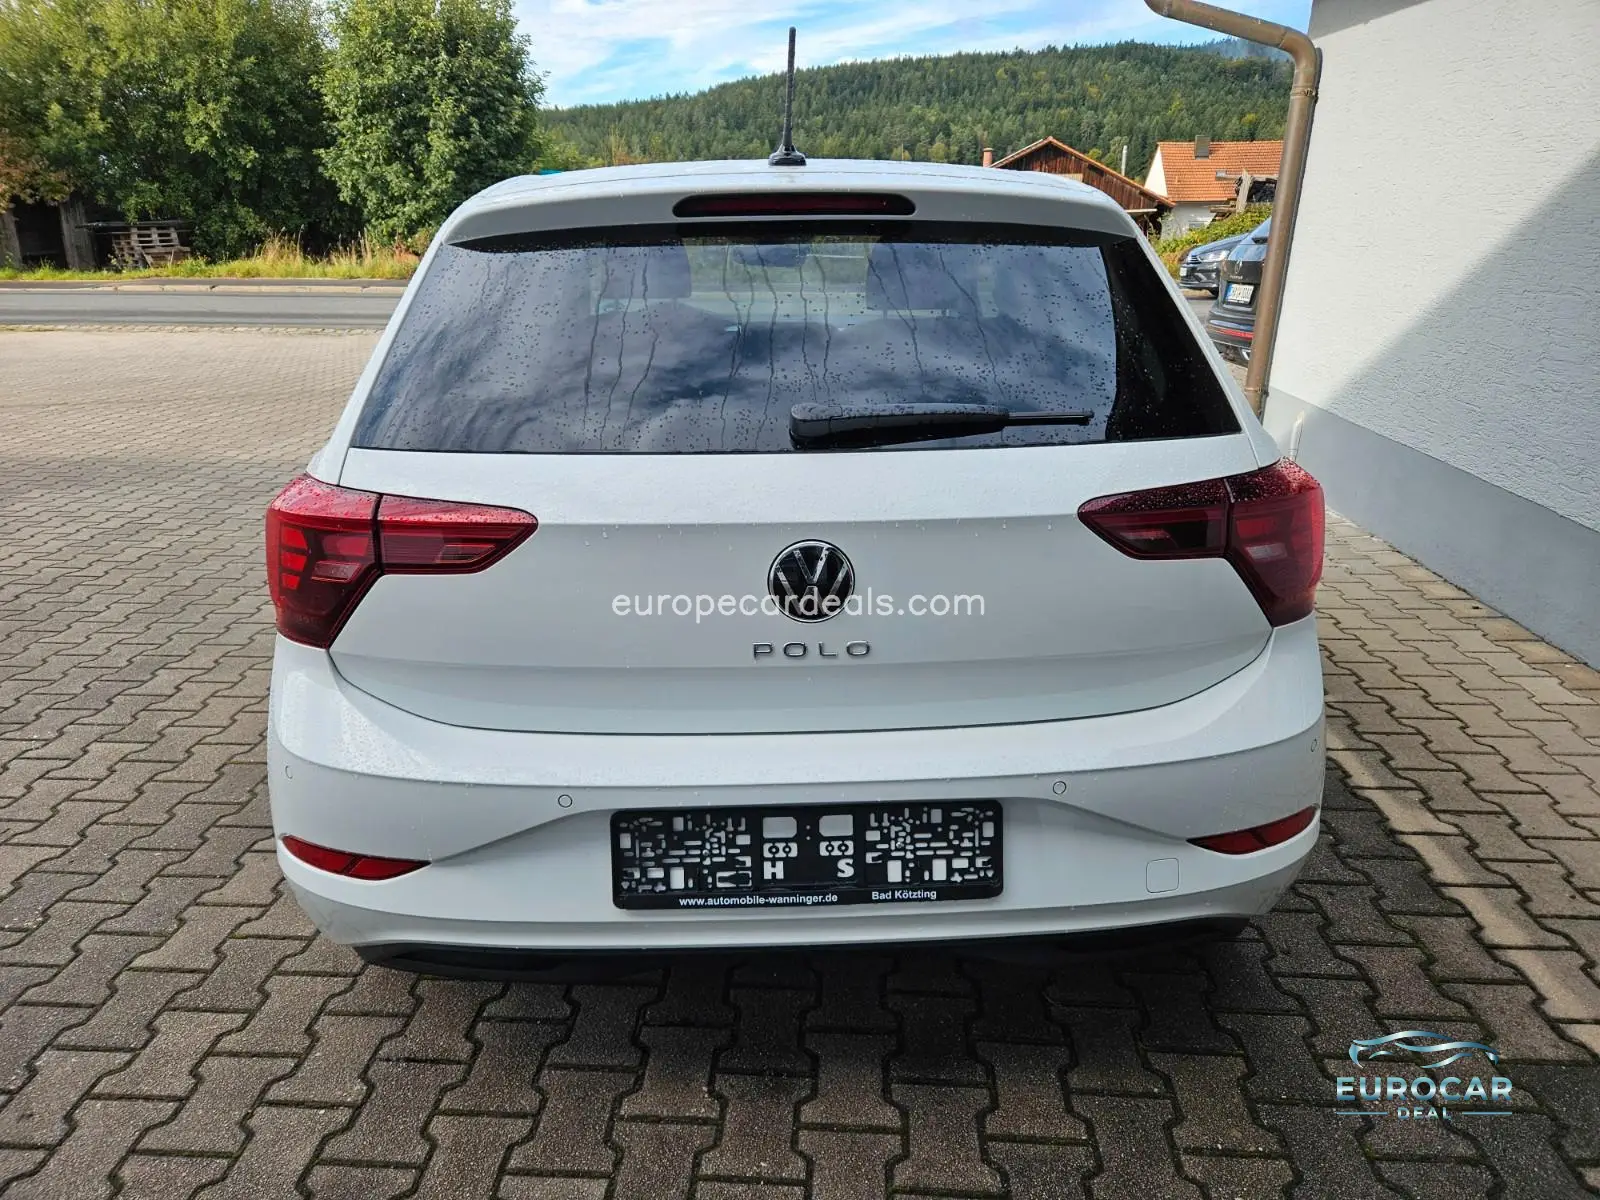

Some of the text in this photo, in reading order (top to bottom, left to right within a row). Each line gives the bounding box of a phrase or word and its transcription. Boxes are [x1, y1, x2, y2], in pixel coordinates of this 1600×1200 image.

[771, 544, 852, 619] VW
[753, 640, 872, 659] POLO
[679, 893, 838, 907] www.automobile-wanninger.de
[871, 888, 937, 901] Bad Kötzting
